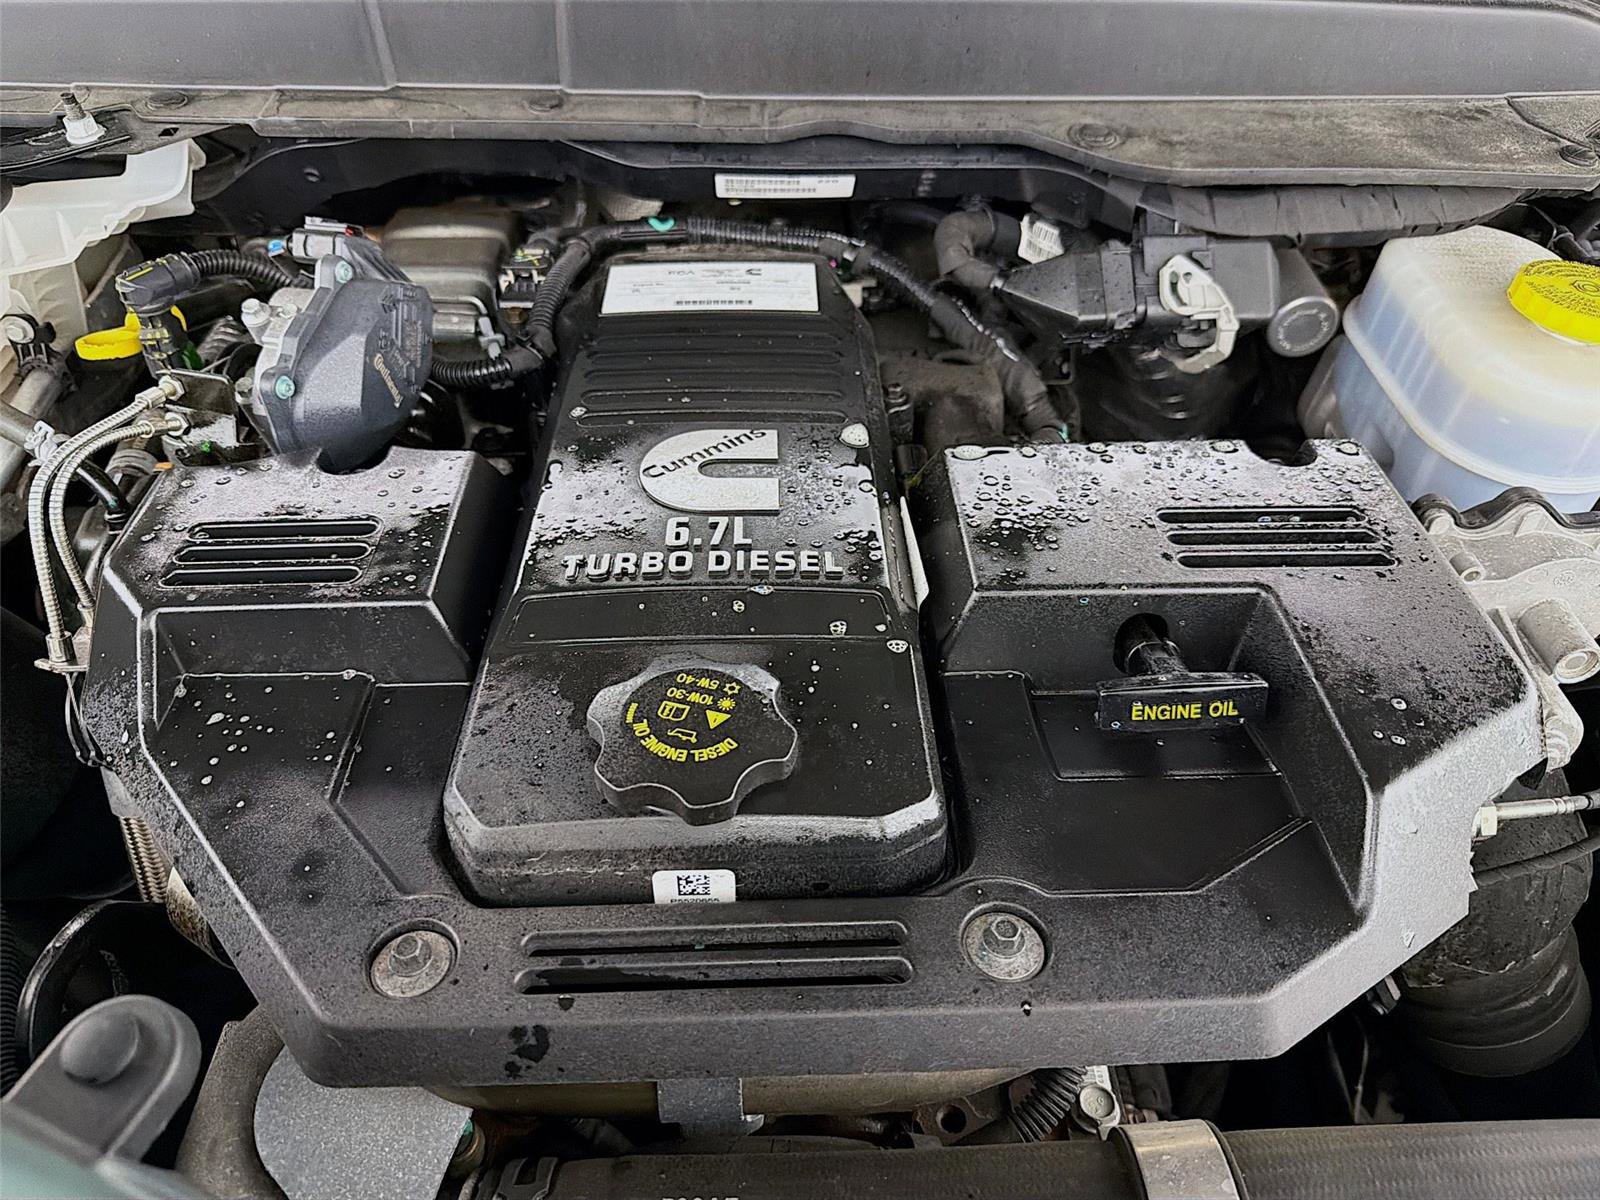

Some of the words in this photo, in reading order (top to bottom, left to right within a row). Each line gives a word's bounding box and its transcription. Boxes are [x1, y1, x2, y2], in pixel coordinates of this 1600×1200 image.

[642, 429, 767, 479] Cummins
[665, 516, 752, 548] 6.7L
[562, 551, 693, 581] TURBO
[707, 550, 844, 577] DIESEL
[676, 672, 719, 690] 5W-40
[667, 686, 714, 706] 10W-30
[1131, 704, 1202, 721] ENGINE
[1208, 700, 1239, 717] OIL
[632, 718, 650, 737] OIL
[640, 734, 688, 762] ENGINE
[690, 737, 738, 762] DIESEL
